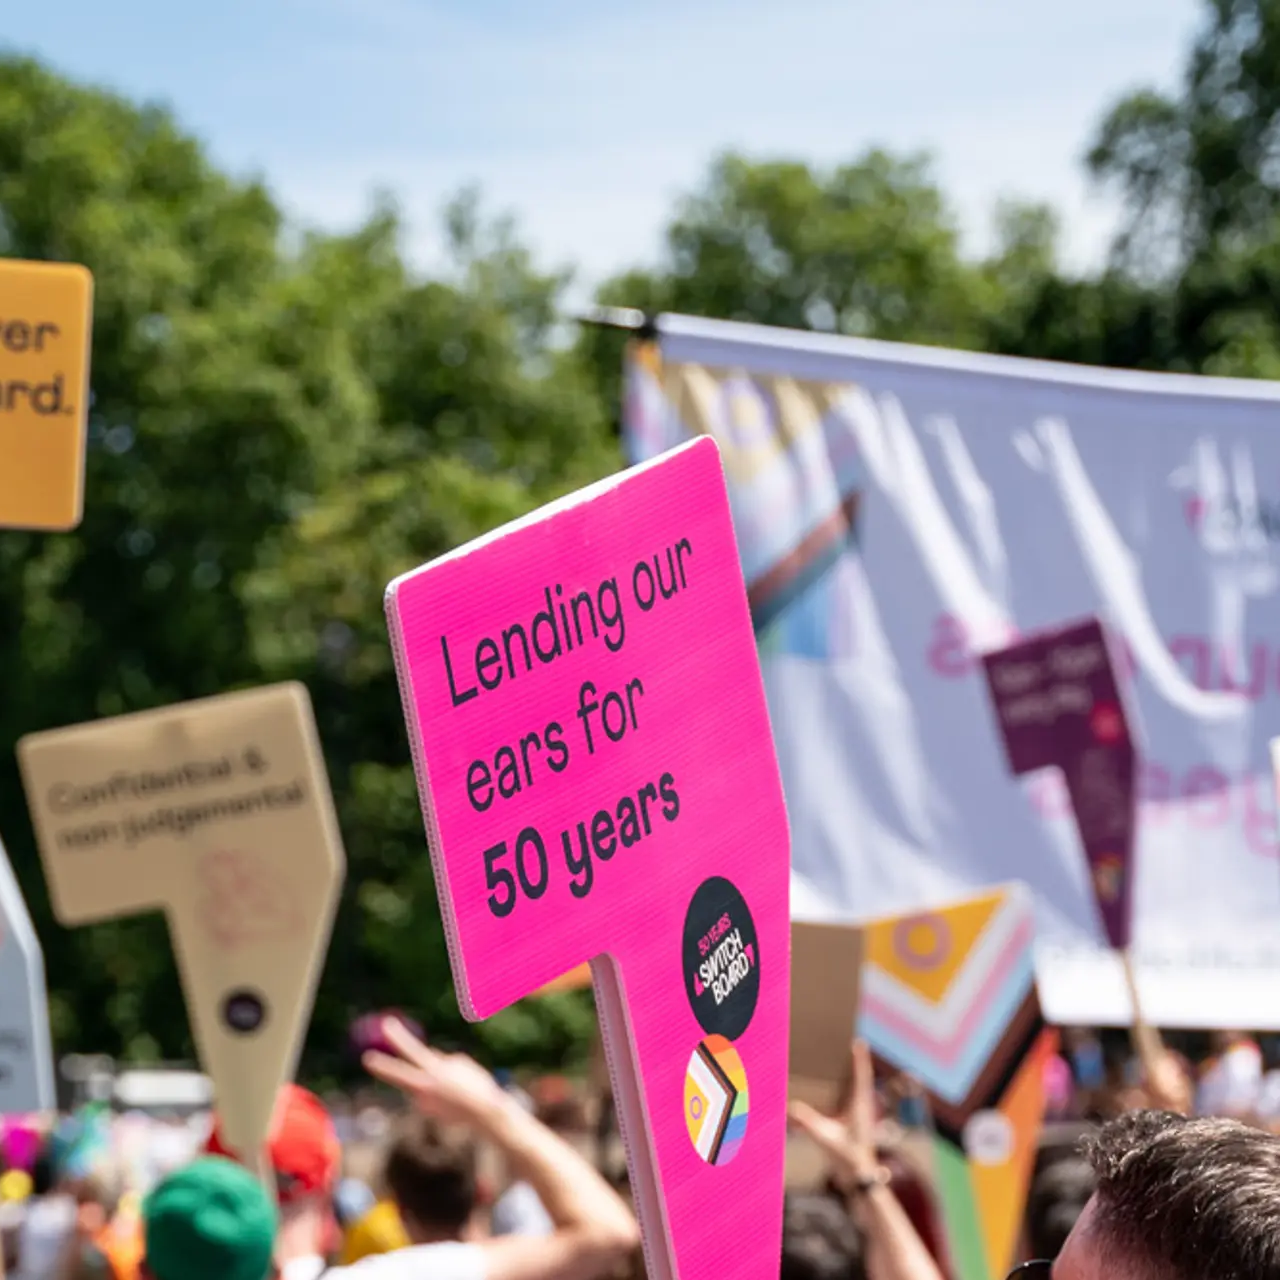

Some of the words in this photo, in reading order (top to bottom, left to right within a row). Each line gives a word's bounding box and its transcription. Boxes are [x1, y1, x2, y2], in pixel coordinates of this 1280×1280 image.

[439, 577, 625, 707] Lending
[631, 537, 692, 612] our
[465, 720, 570, 813] ears
[577, 676, 644, 755] for
[482, 825, 550, 918] 50
[560, 771, 680, 899] years
[699, 927, 744, 989] SWITCH
[711, 951, 750, 1006] BOARD
